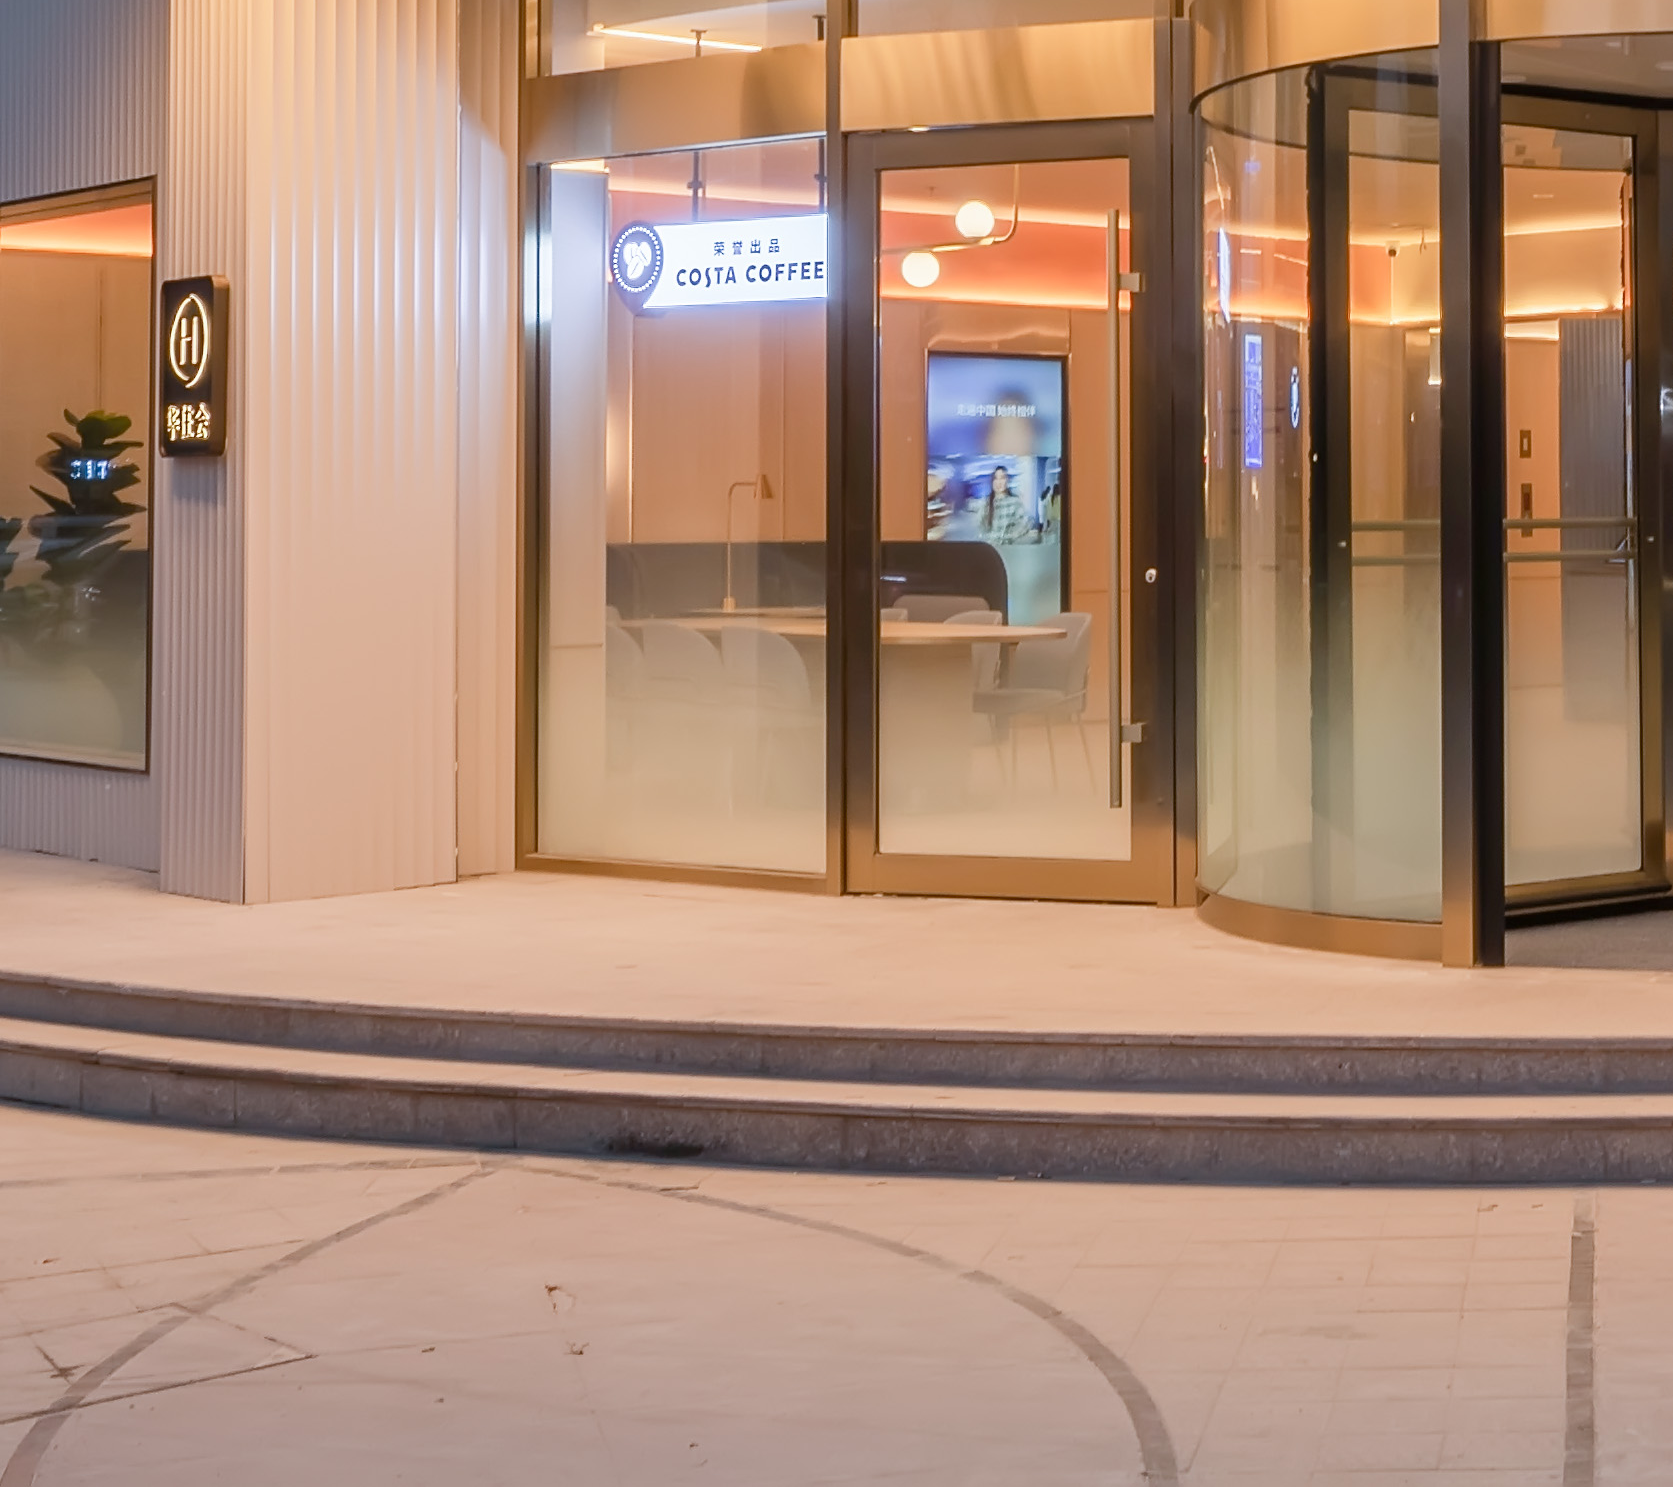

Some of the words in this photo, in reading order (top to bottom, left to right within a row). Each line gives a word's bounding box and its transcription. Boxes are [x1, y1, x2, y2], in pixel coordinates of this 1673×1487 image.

[713, 237, 781, 257] 荣誉出品
[676, 266, 737, 289] COSTA
[745, 260, 825, 283] COFFEE
[166, 401, 212, 442] 华住会
